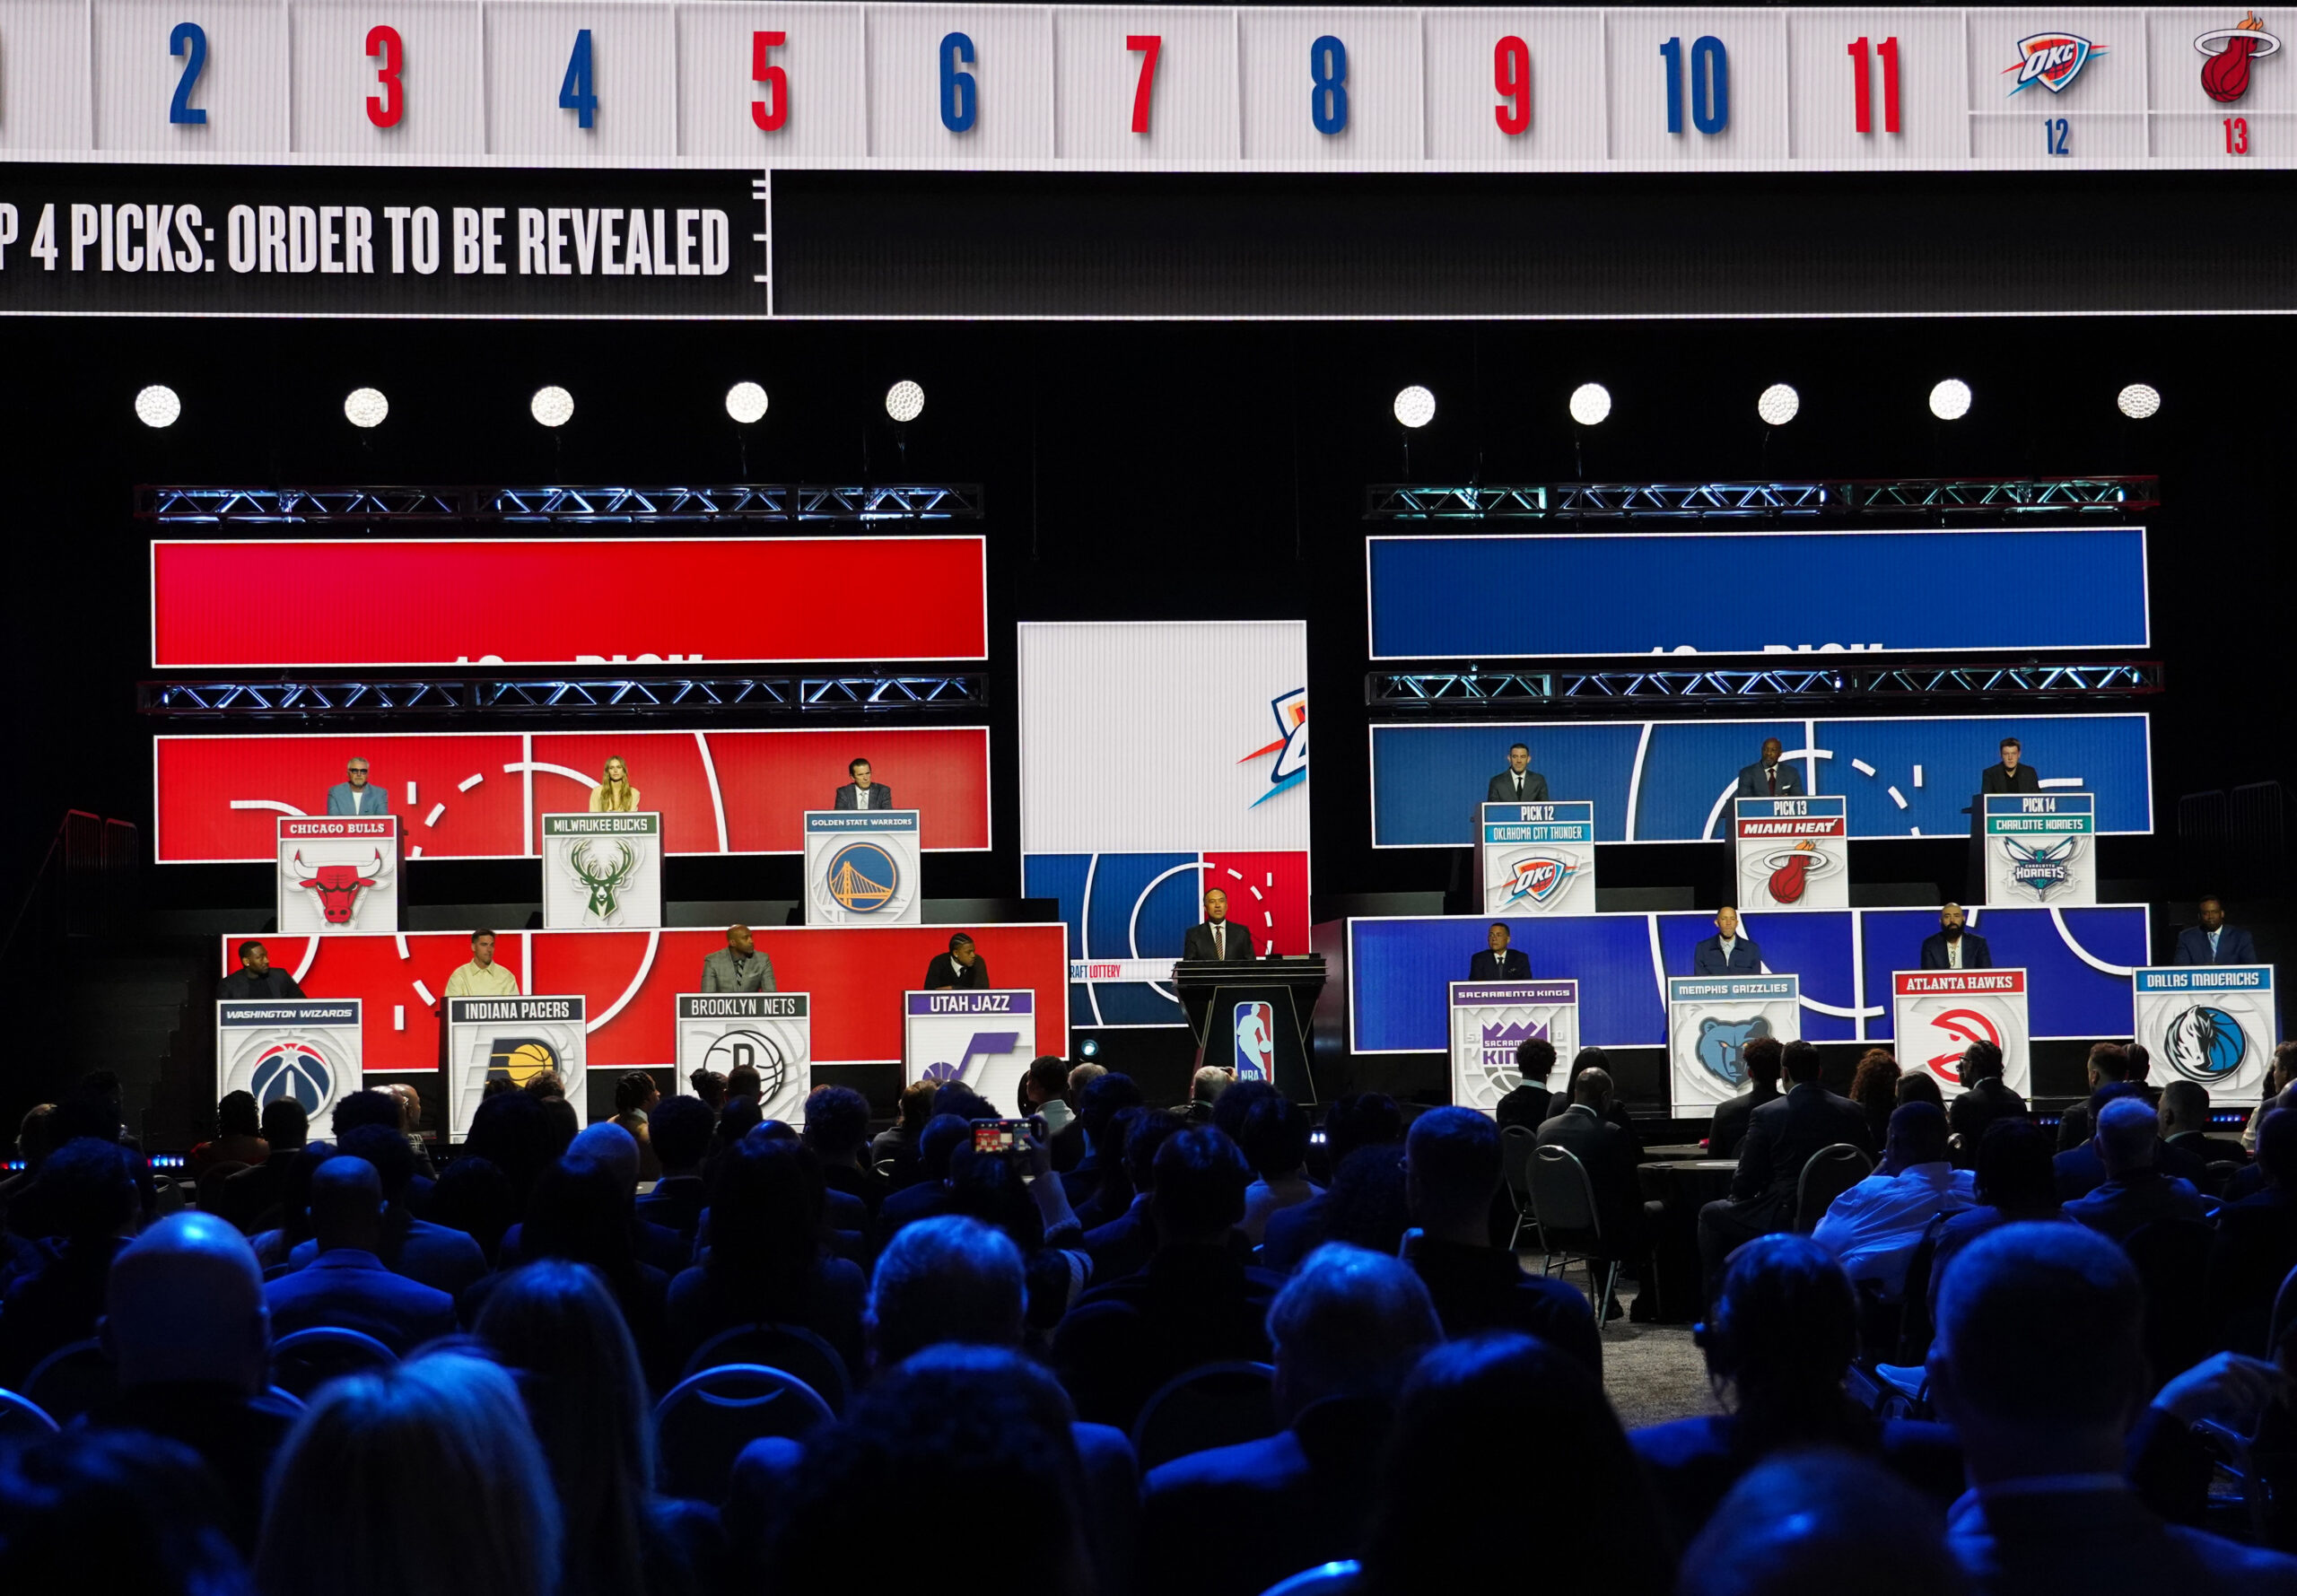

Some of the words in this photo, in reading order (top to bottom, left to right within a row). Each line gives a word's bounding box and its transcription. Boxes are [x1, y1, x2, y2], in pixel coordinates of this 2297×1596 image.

[2020, 44, 2075, 83] OKC
[170, 22, 207, 125] 2
[365, 25, 404, 128] 3
[559, 29, 598, 128] 4
[751, 31, 788, 132] 5
[939, 32, 976, 133] 6
[1126, 35, 1161, 133] 7
[1311, 35, 1348, 135] 8
[1494, 35, 1531, 135] 9
[1660, 35, 1729, 135] 10
[1847, 36, 1900, 134] 11
[2045, 118, 2069, 154] 12
[2223, 118, 2248, 154] 13
[31, 204, 57, 270] 4
[72, 204, 215, 272] PICKS:
[228, 205, 371, 274] ORDER
[385, 207, 439, 274] TO
[454, 208, 505, 275] BE
[520, 209, 729, 275] REVEALED
[1521, 806, 1542, 821] PICK
[1544, 806, 1554, 821] 12
[1774, 800, 1795, 815] PICK
[1796, 800, 1807, 815] 13
[2022, 798, 2044, 813] PICK
[2046, 798, 2056, 812] 14
[290, 824, 344, 833] CHICAGO
[348, 824, 384, 833] BULLS
[554, 820, 611, 832] MILWAUKEE
[613, 819, 647, 831] BUCKS
[1493, 827, 1532, 841] OKLAHOMA
[1533, 826, 1548, 840] CITY
[1550, 826, 1582, 839] THUNDER
[1743, 824, 1793, 834] MIAMI
[1795, 818, 1838, 833] HEAT
[1996, 820, 2043, 831] CHARLOTTE
[2046, 819, 2083, 830] HORNETS
[1514, 865, 1554, 895] OKC
[2016, 867, 2065, 879] HORNETS
[1089, 964, 1121, 978] LOTTERY
[2146, 973, 2188, 987] DALLAS
[2192, 972, 2259, 986] MAVERICKS
[1679, 985, 1728, 995] MEMPHIS
[1732, 984, 1788, 994] GRIZZLIES
[1907, 977, 1966, 990] ATLANTA
[1967, 976, 2013, 989] HAWKS
[1458, 990, 1534, 999] SACRAMENTO
[465, 1003, 518, 1019] INDIANA
[521, 1001, 570, 1018] PACERS
[691, 999, 757, 1016] BROOKLYN
[764, 999, 795, 1014] NETS
[930, 996, 968, 1012] UTAH
[971, 995, 1010, 1011] JAZZ
[227, 1010, 296, 1019] WASHINGTON
[300, 1008, 352, 1017] WIZARDS
[1483, 1050, 1519, 1065] KIN
[1241, 1069, 1260, 1082] NBA
